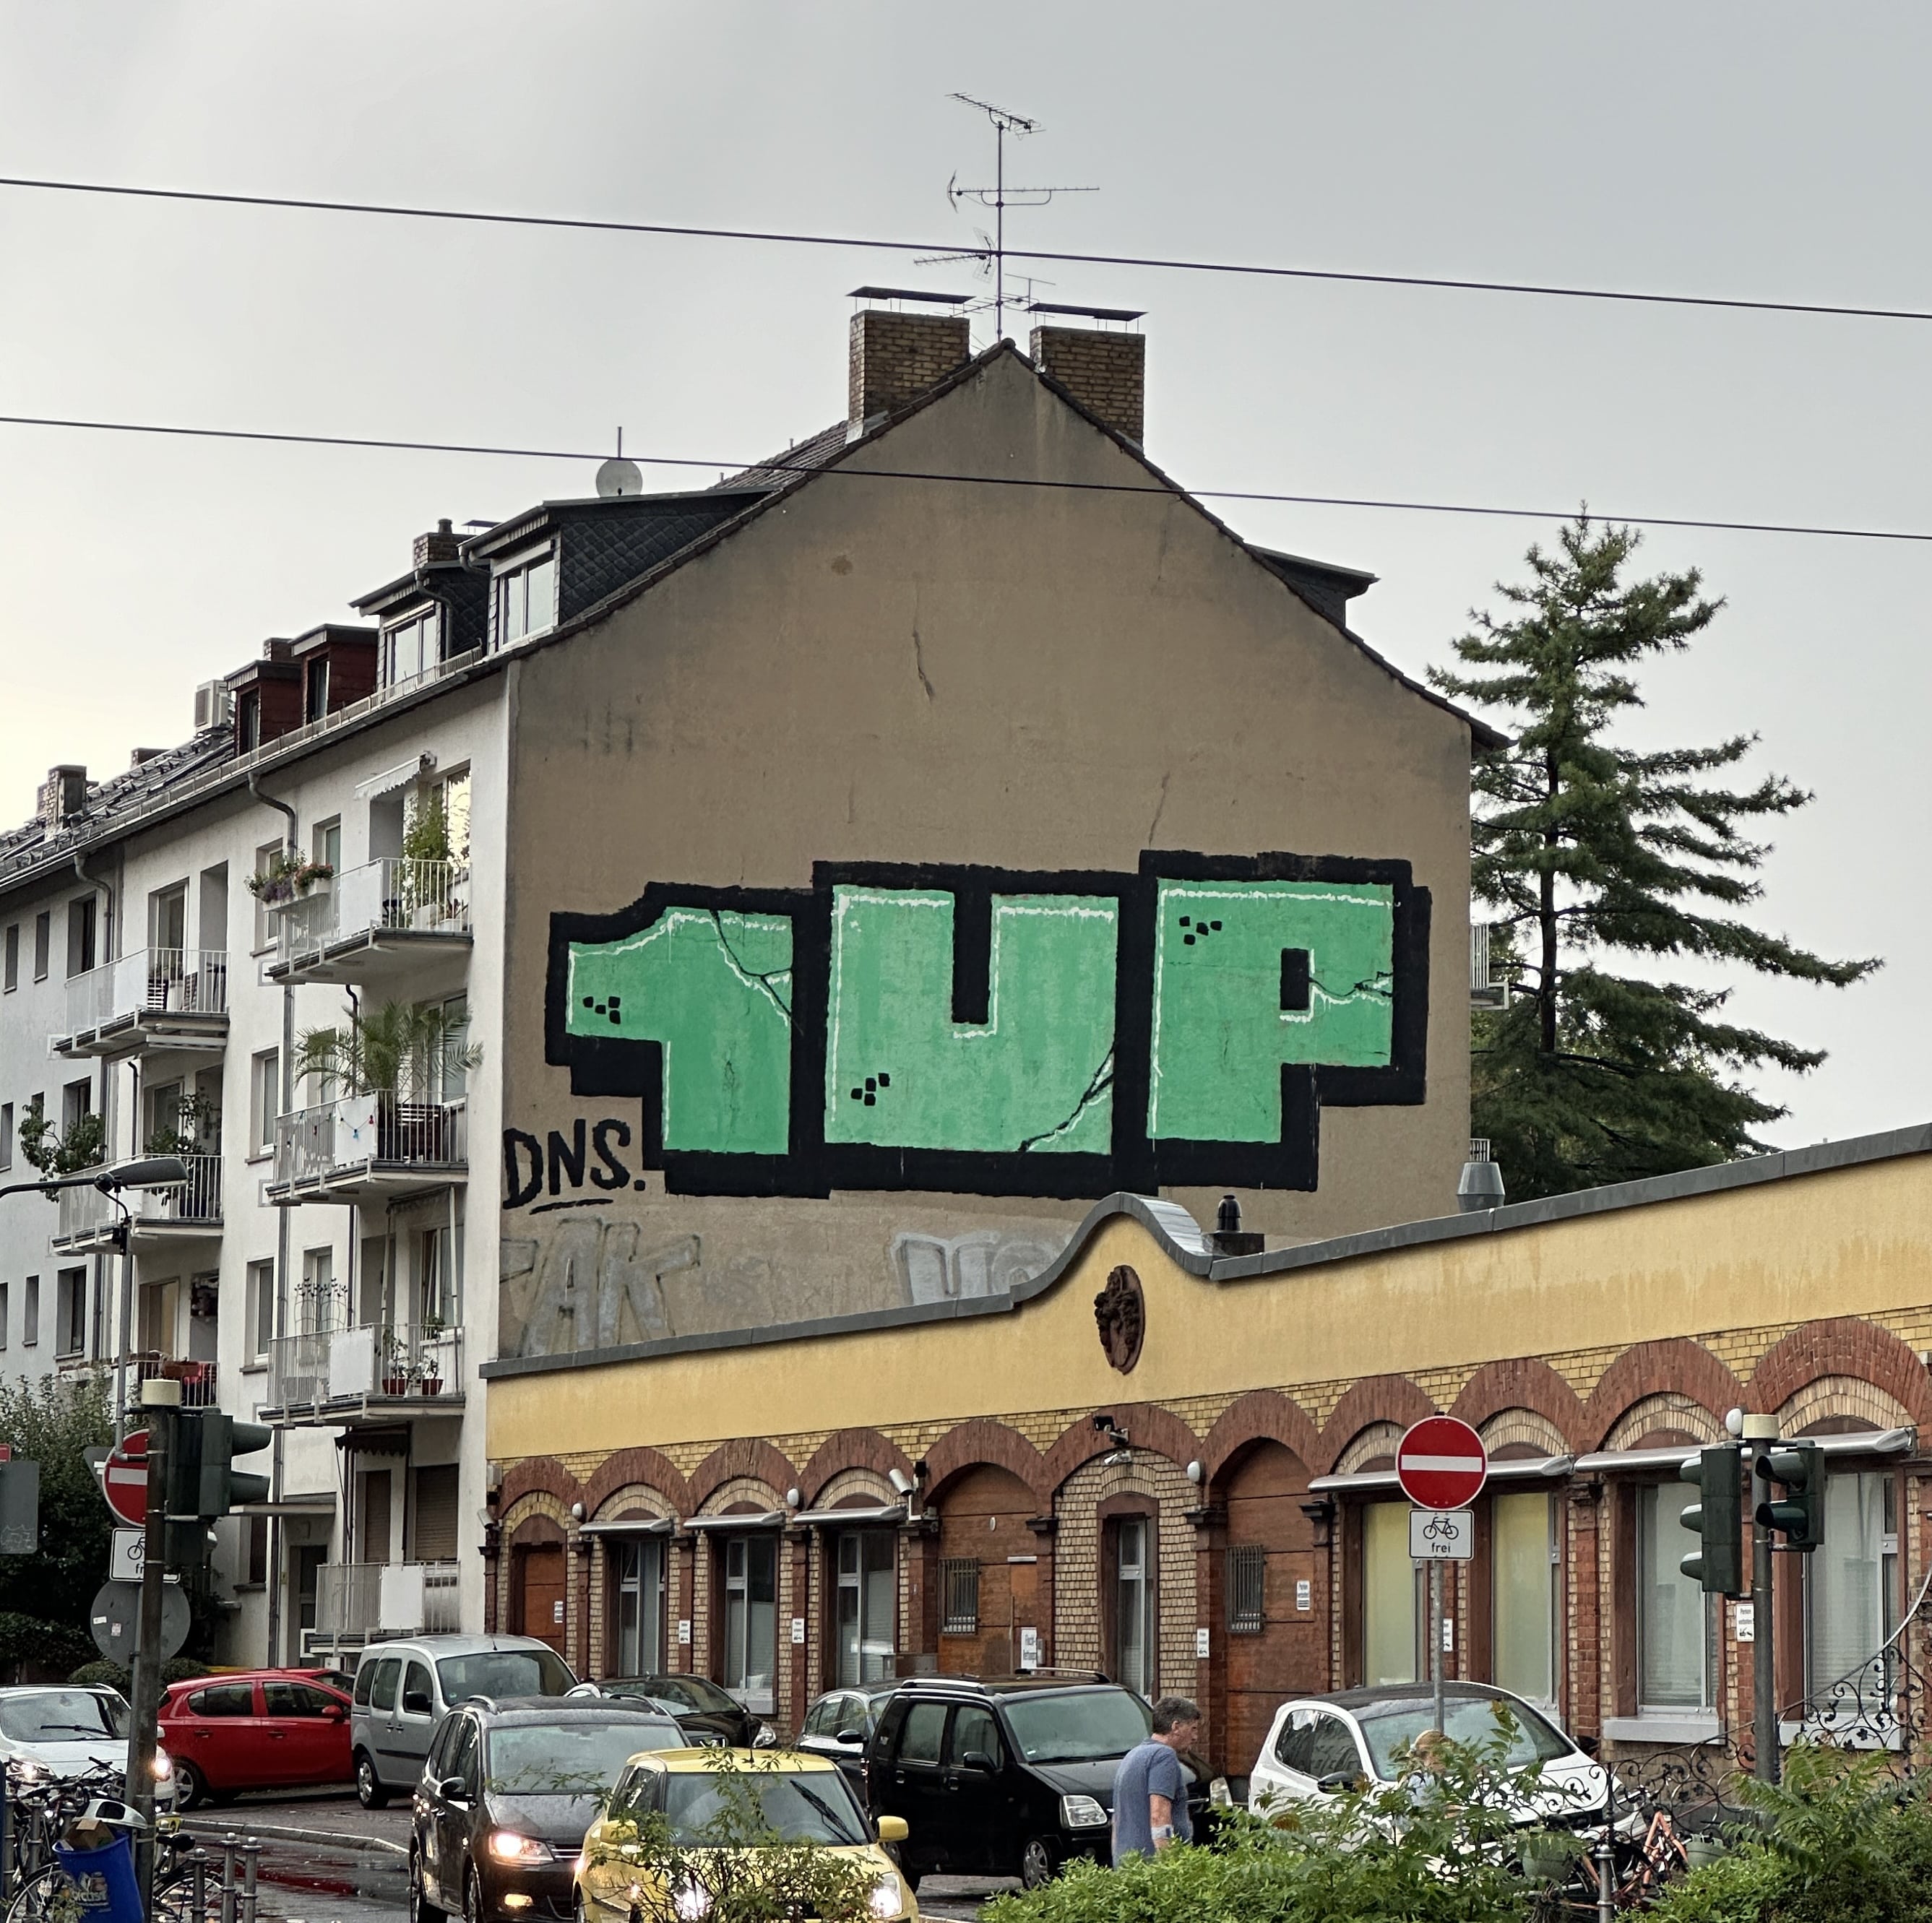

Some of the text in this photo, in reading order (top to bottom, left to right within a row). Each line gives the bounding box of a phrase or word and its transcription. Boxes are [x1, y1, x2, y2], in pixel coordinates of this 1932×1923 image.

[545, 850, 1431, 1199] 1UP
[502, 1119, 645, 1210] DNS.
[1431, 1542, 1451, 1553] frei
